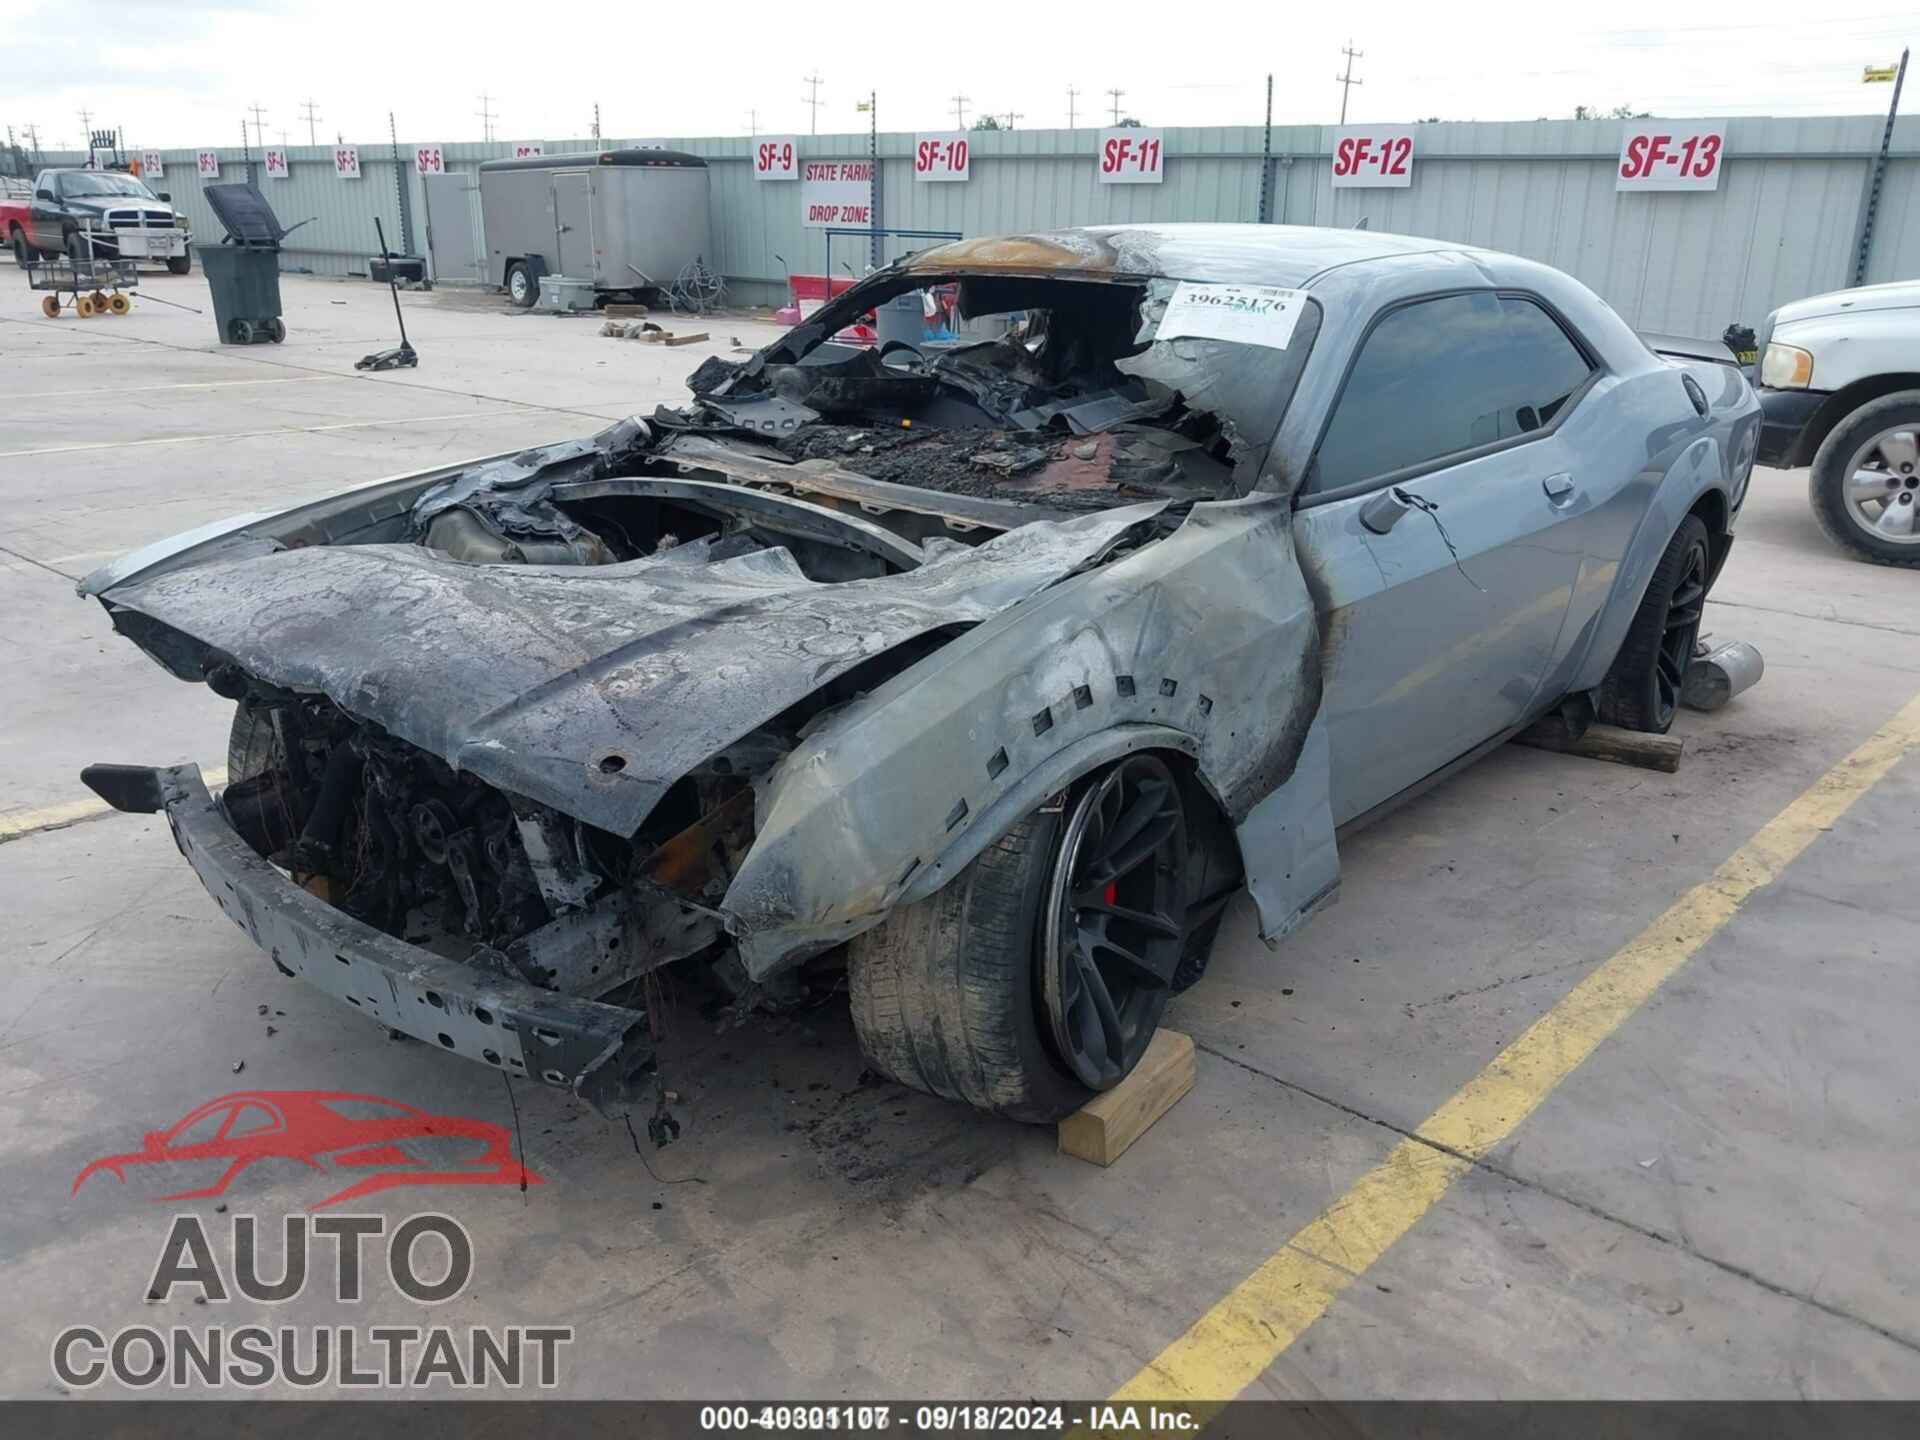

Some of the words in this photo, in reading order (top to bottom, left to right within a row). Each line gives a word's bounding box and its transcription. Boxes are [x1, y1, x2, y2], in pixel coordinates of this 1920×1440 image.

[267, 152, 286, 172] SF-4
[337, 151, 357, 171] SF-5
[418, 150, 441, 172] SF-6
[758, 143, 792, 172] SF-9
[917, 140, 967, 172] SF-10
[1103, 139, 1160, 173] SF-11
[1334, 138, 1412, 176] SF-12
[1620, 134, 1722, 179] SF-13
[806, 164, 837, 181] STATE
[809, 205, 839, 222] DROP
[841, 206, 869, 223] ZONE
